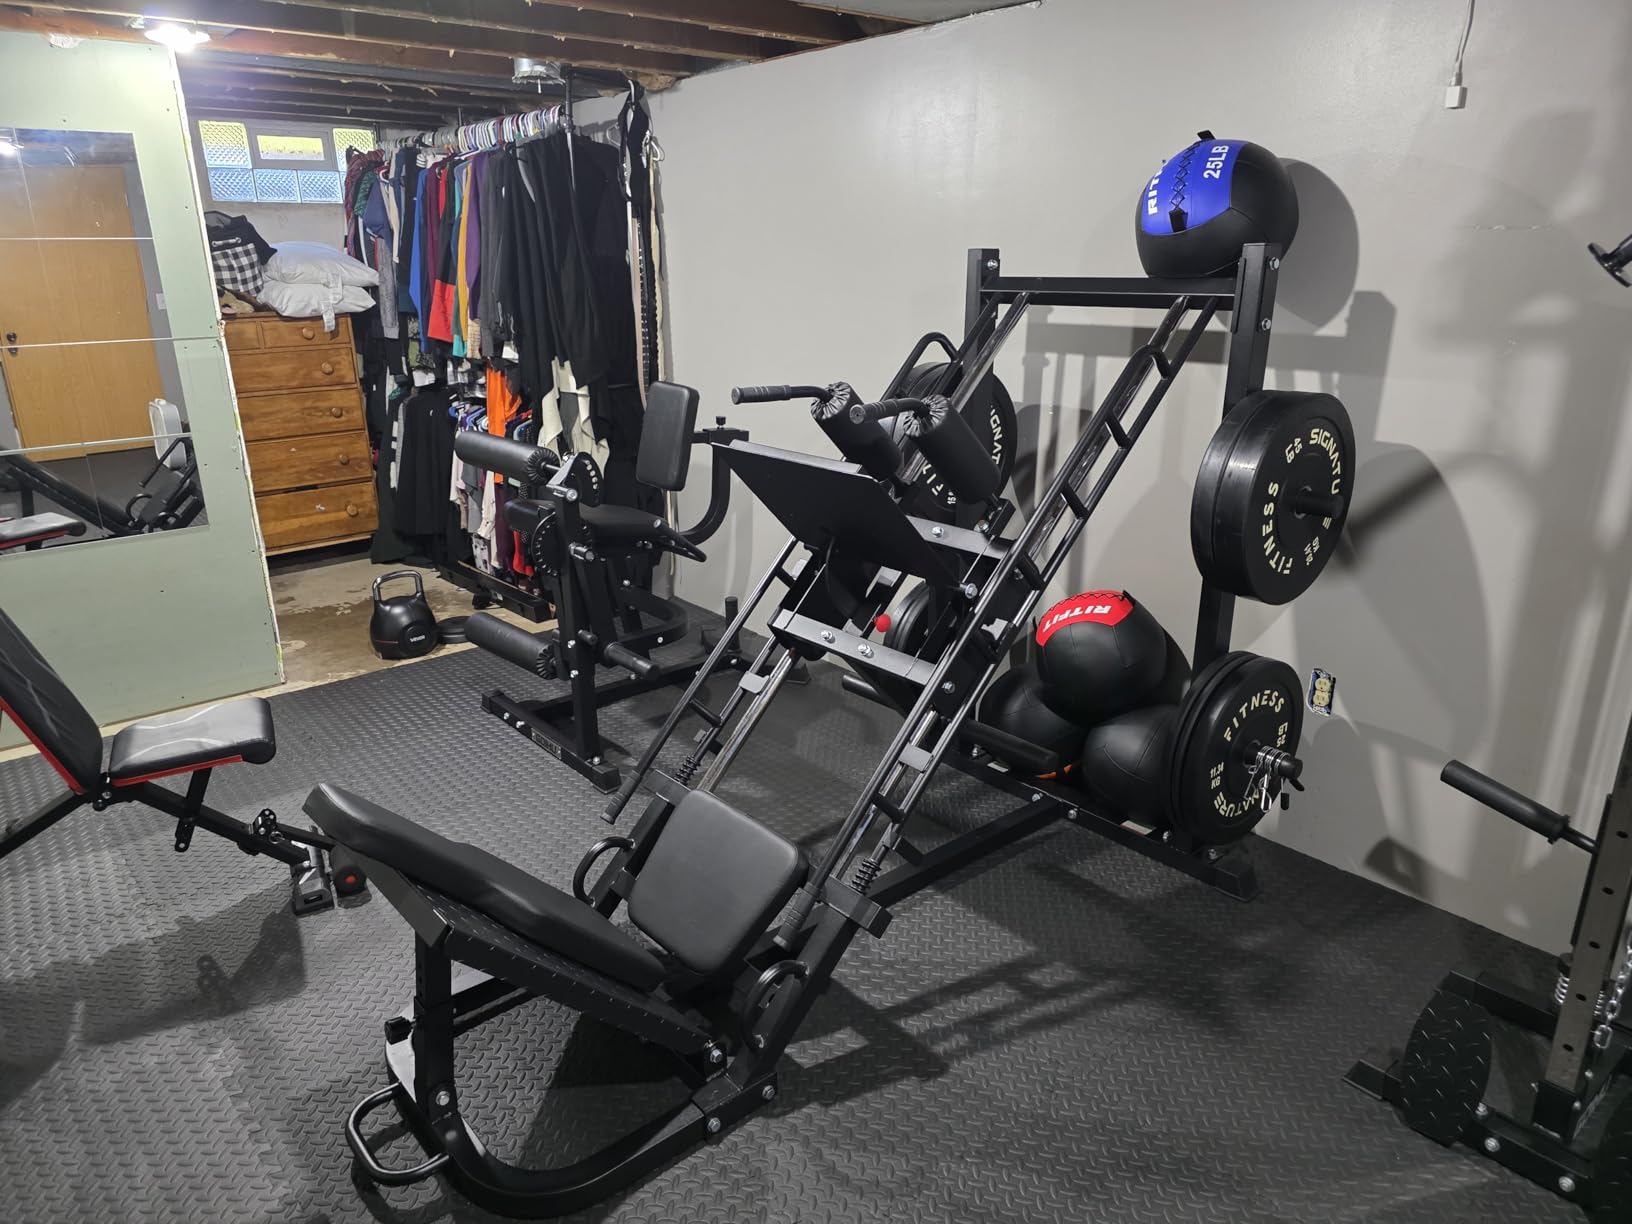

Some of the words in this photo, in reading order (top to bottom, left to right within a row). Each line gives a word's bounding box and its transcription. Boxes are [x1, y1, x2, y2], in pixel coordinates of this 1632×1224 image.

[1203, 145, 1229, 179] 25LB
[1285, 443, 1295, 464] LB
[1293, 437, 1303, 454] 45
[1309, 428, 1341, 530] SIGNATUE
[1262, 481, 1293, 575] FITNESS
[1042, 605, 1112, 633] RITFIT
[1223, 689, 1285, 742] FITNESS
[1278, 722, 1289, 736] LB
[1210, 761, 1224, 779] 11.34
[1211, 776, 1221, 790] KG
[1213, 788, 1260, 818] NATURE
